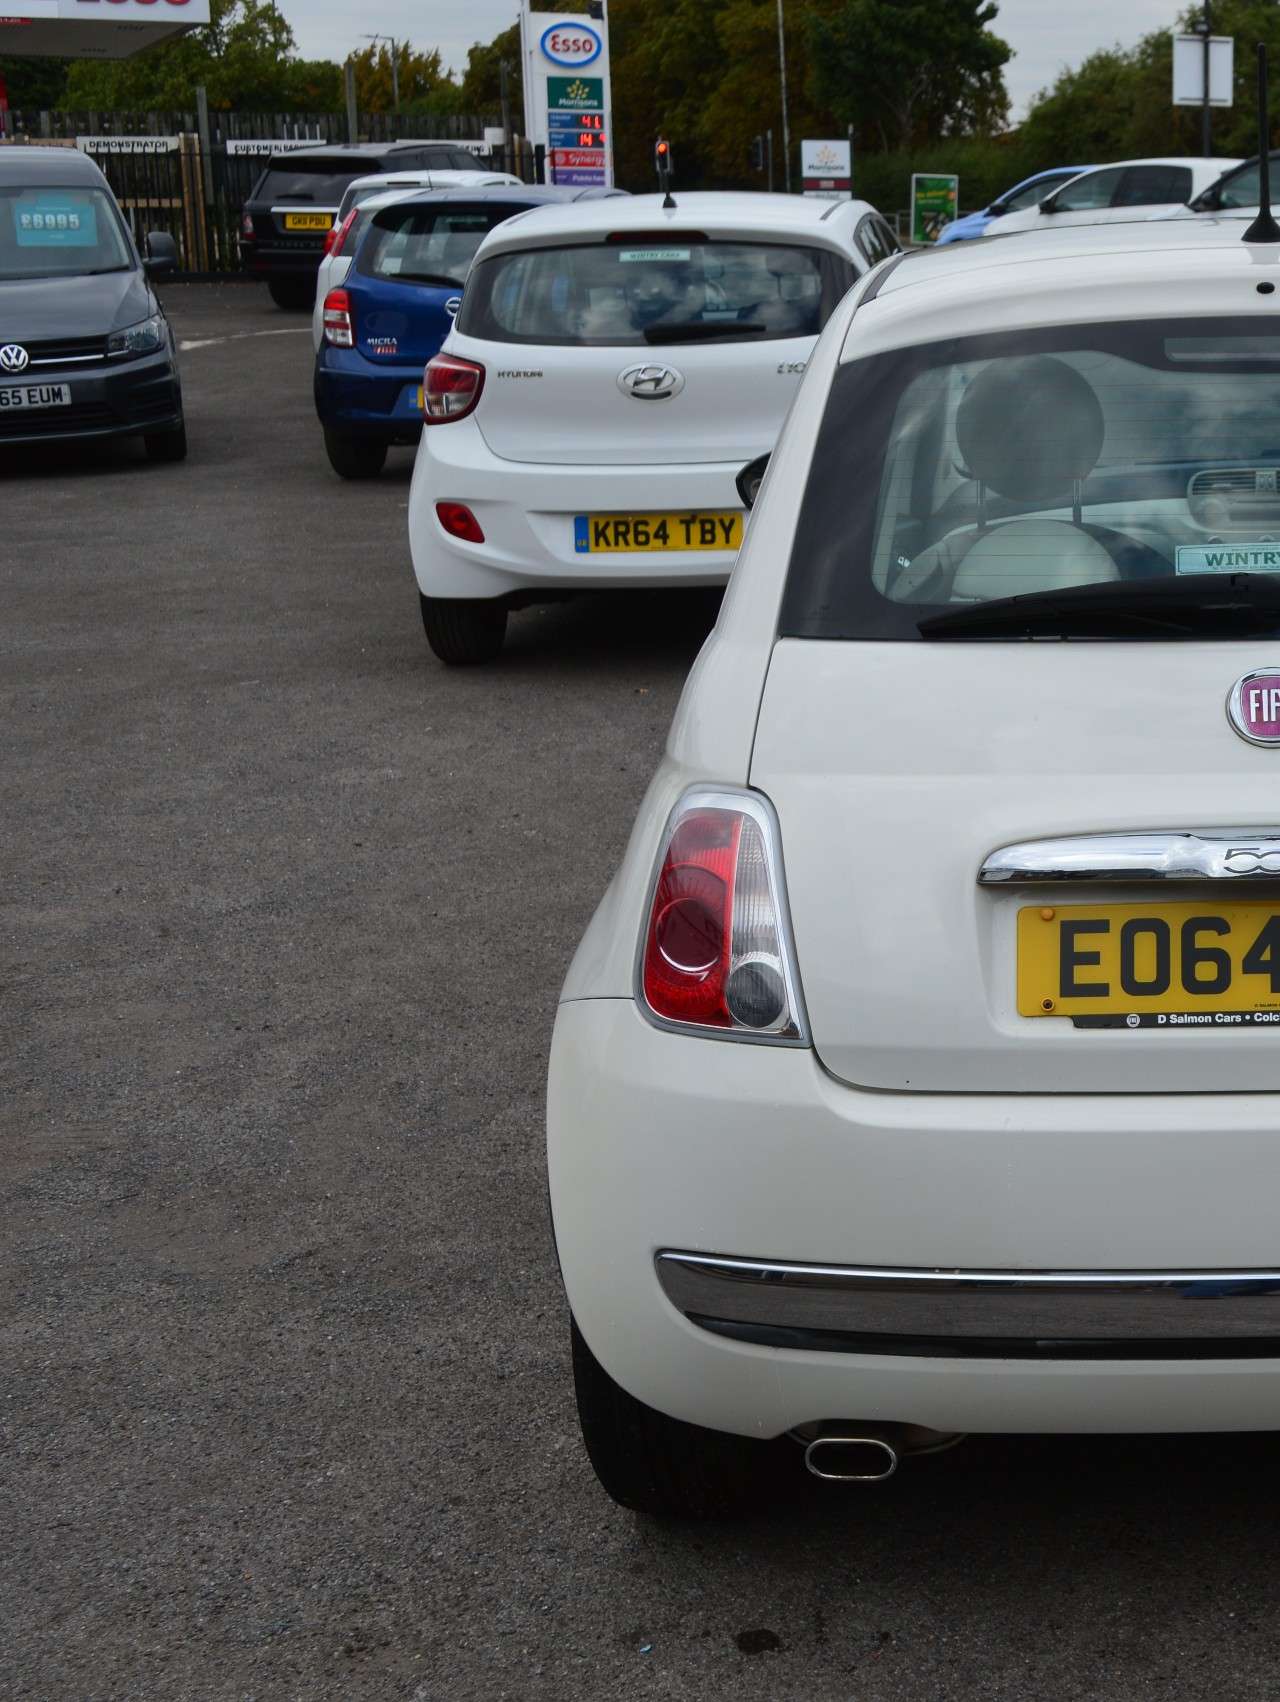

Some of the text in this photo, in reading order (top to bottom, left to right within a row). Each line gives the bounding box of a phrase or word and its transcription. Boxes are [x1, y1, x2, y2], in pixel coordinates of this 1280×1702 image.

[88, 140, 169, 149] DEMONSTRATOR
[367, 337, 398, 345] MICRA
[0, 386, 63, 406] 65 EUM
[593, 517, 736, 548] KR64 TBY
[1157, 1014, 1167, 1024] D
[1169, 1013, 1212, 1024] Salmon
[1214, 1013, 1242, 1023] Cars
